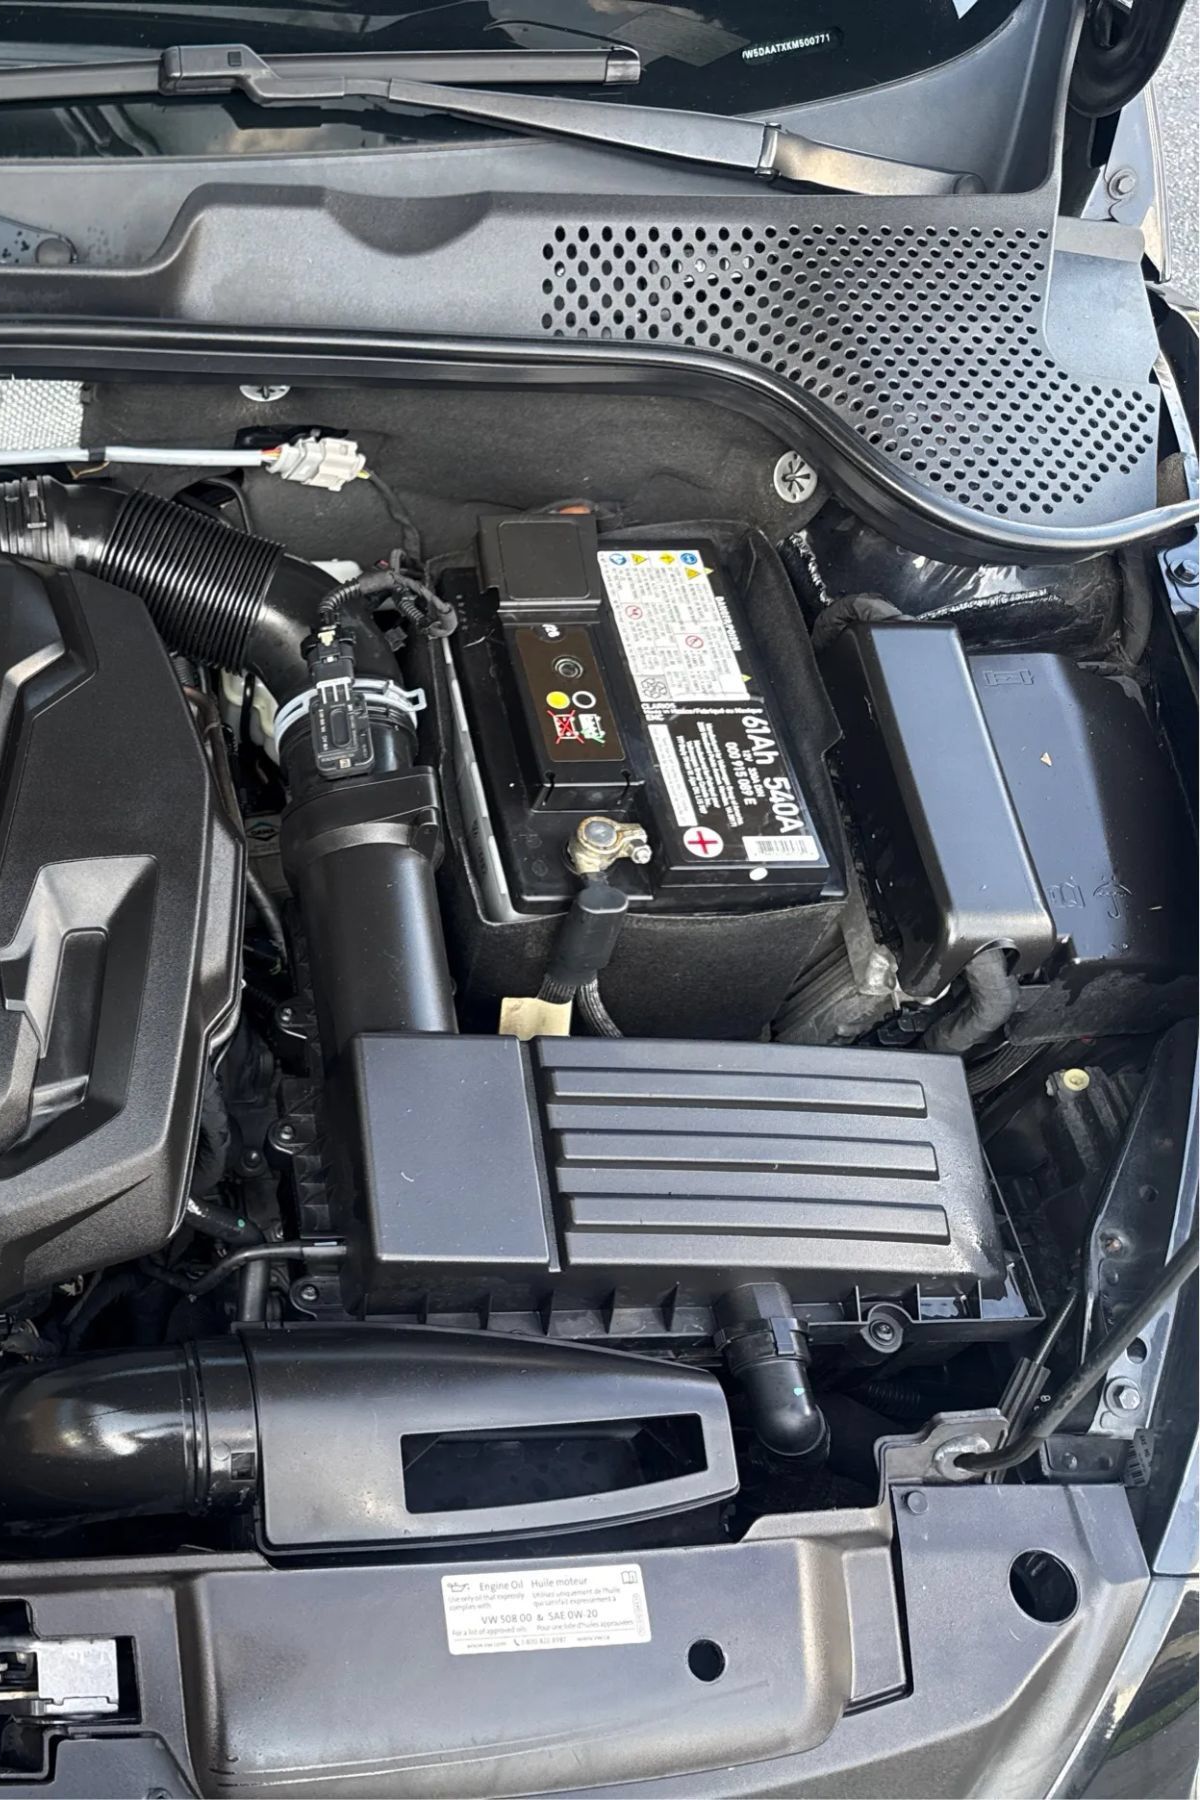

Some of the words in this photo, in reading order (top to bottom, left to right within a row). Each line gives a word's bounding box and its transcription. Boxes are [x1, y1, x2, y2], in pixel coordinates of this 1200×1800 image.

[742, 715, 780, 764] 61Ah
[764, 776, 804, 834] 540A
[480, 1582, 510, 1592] Engine
[510, 1580, 524, 1589] Oil
[531, 1578, 554, 1588] Huile
[556, 1578, 588, 1586] moteur
[481, 1616, 498, 1624] VW
[500, 1614, 518, 1623] 508
[520, 1613, 532, 1622] 00
[548, 1612, 565, 1620] SAE
